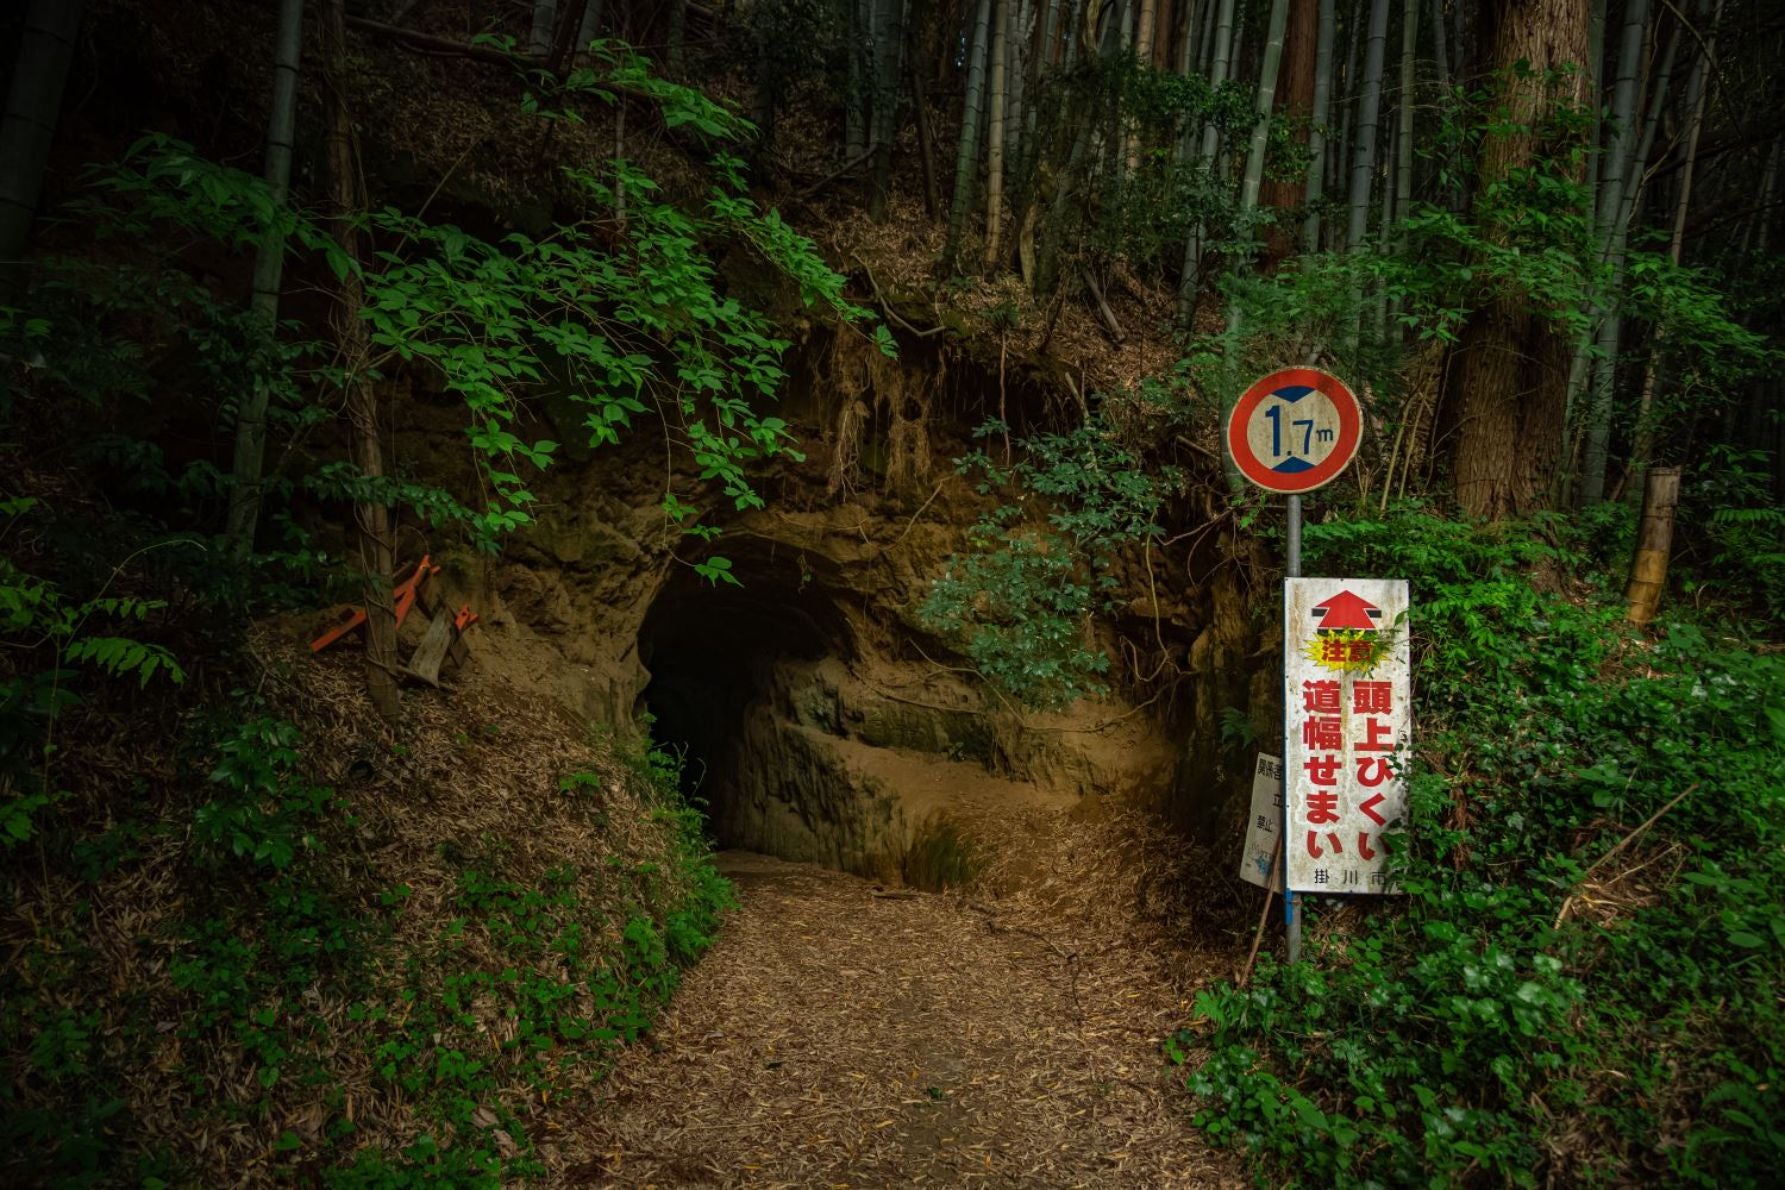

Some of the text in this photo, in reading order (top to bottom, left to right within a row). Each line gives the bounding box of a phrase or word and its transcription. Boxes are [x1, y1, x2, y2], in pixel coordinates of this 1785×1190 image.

[1302, 680, 1342, 859] 道幅せまい
[1352, 681, 1394, 860] 頭上ひくい
[1314, 868, 1386, 885] 掛川市
